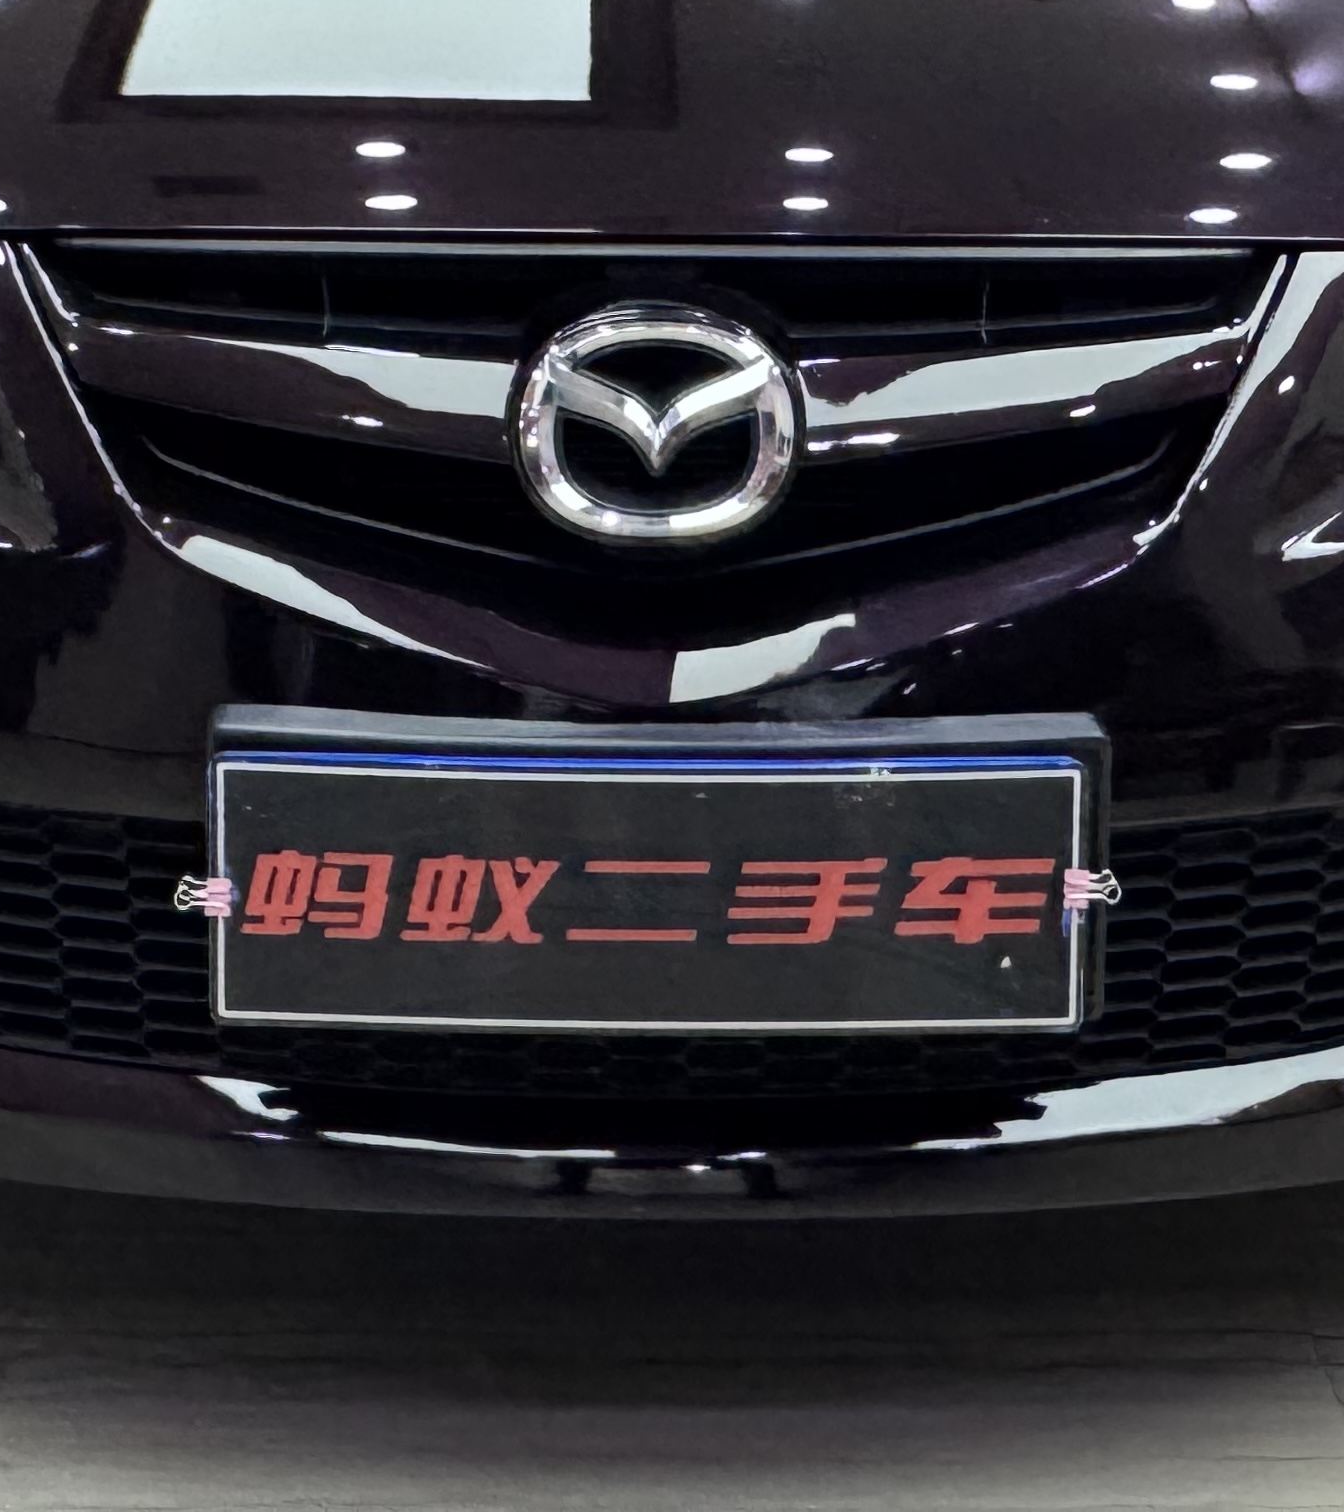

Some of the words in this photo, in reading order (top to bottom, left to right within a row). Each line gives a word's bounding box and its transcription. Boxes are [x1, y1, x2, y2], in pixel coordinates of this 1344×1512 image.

[241, 849, 1055, 944] 蚂蚁二手车
